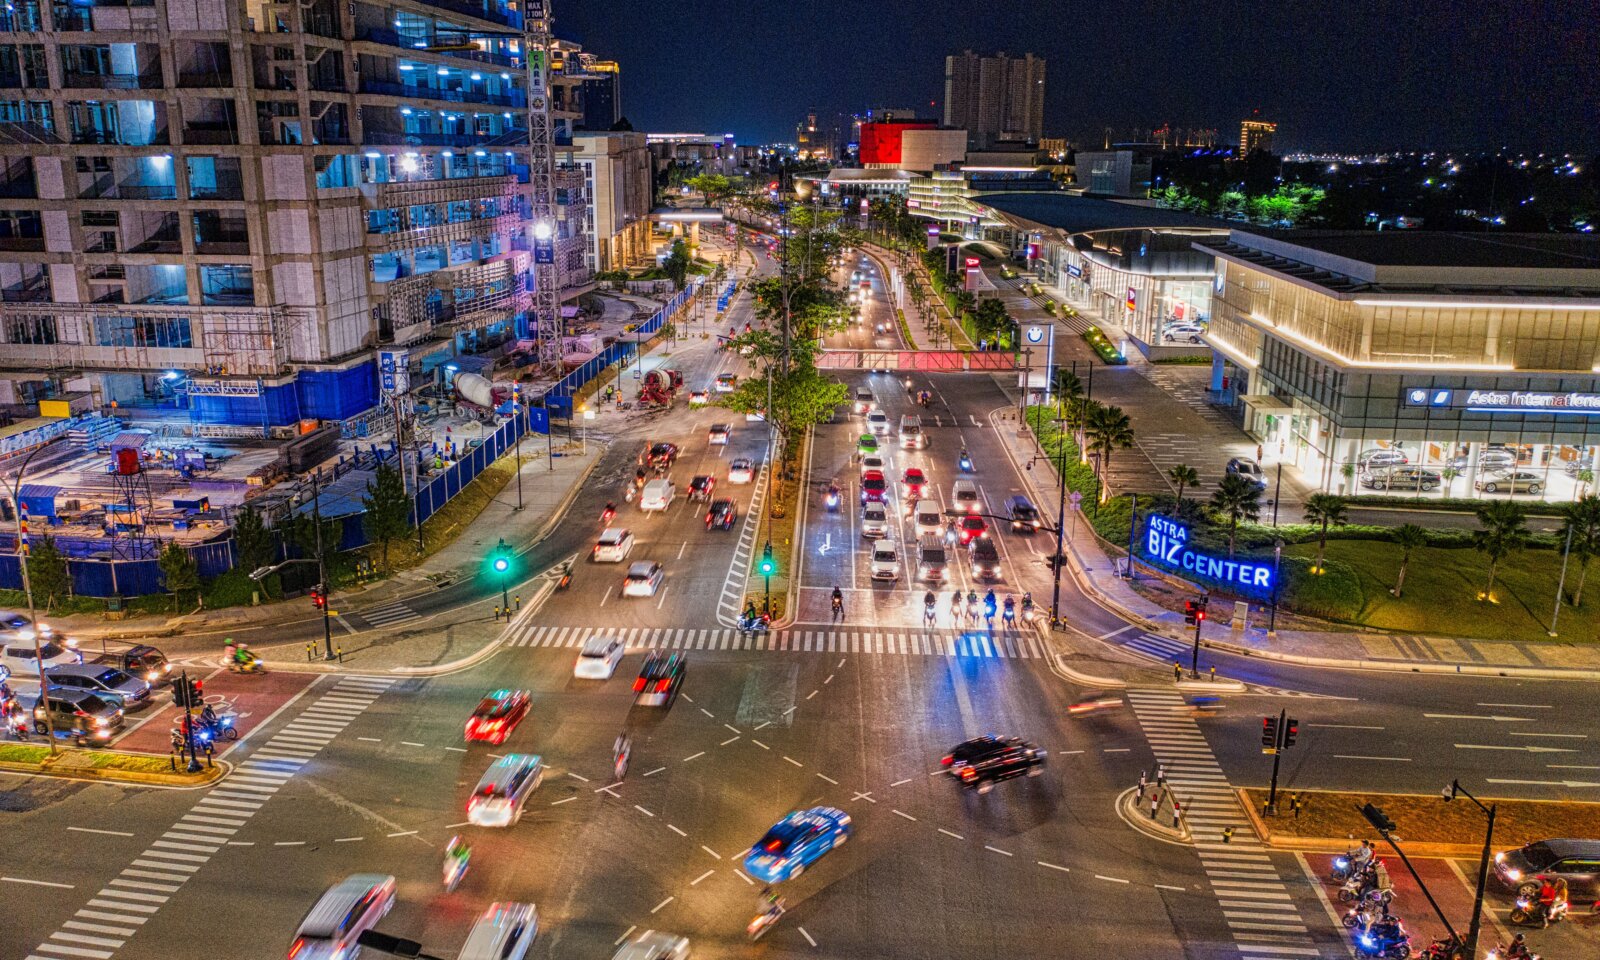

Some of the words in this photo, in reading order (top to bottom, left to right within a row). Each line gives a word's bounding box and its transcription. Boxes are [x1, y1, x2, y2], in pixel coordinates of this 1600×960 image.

[533, 54, 541, 86] CARE
[1466, 390, 1510, 405] Astra
[1150, 515, 1186, 540] ASTRA
[1148, 529, 1184, 566] BIZ
[1182, 551, 1270, 587] CENTER
